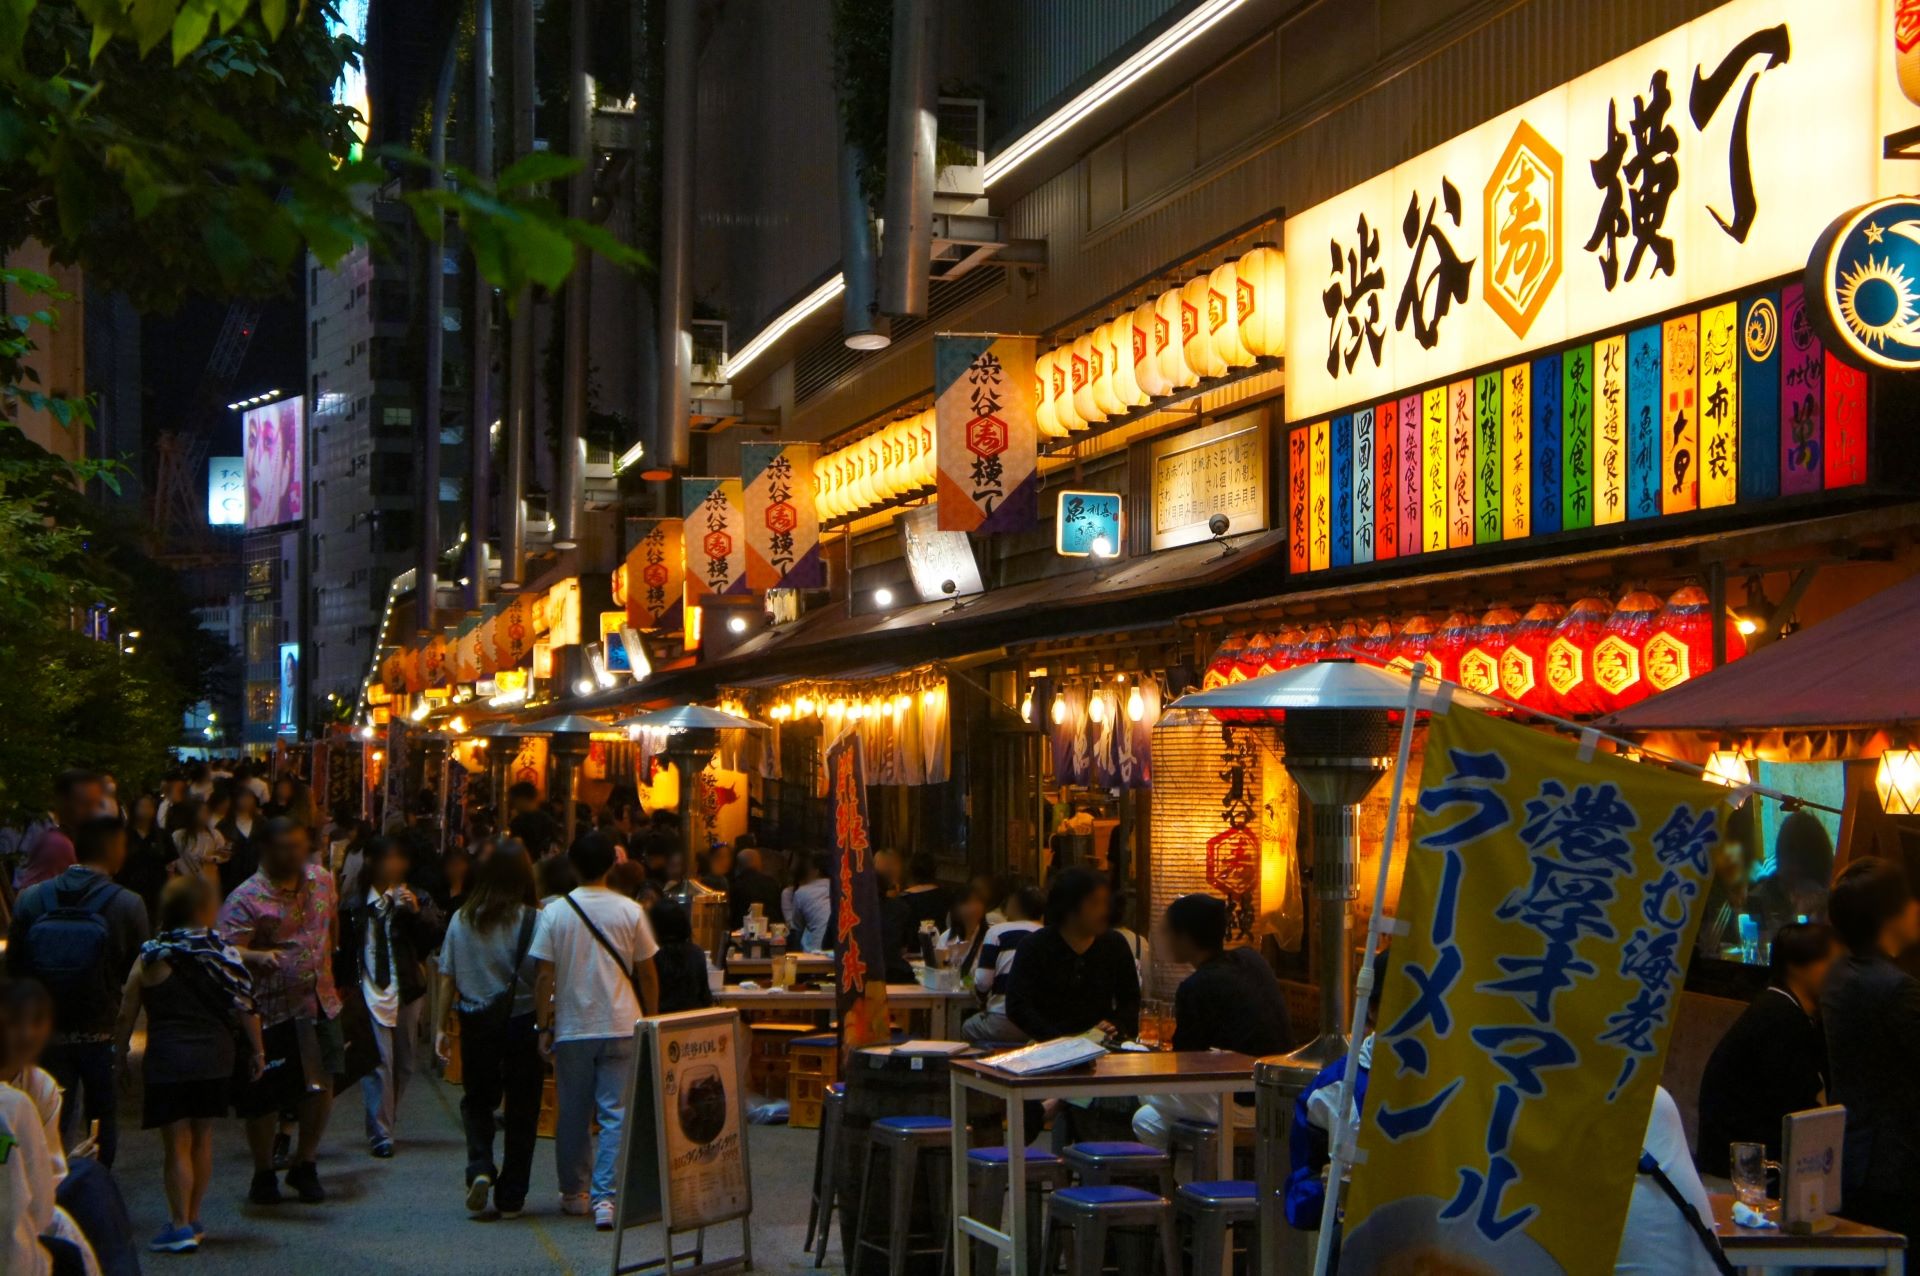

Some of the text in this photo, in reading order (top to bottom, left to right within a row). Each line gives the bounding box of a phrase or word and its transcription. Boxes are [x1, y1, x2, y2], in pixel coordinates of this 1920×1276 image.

[1322, 174, 1477, 380] 渋谷
[1583, 22, 1791, 292] 横丁
[1356, 411, 1373, 559] 四国食市
[1569, 352, 1588, 523] 東北食市
[1375, 748, 1509, 1141] ラーメン
